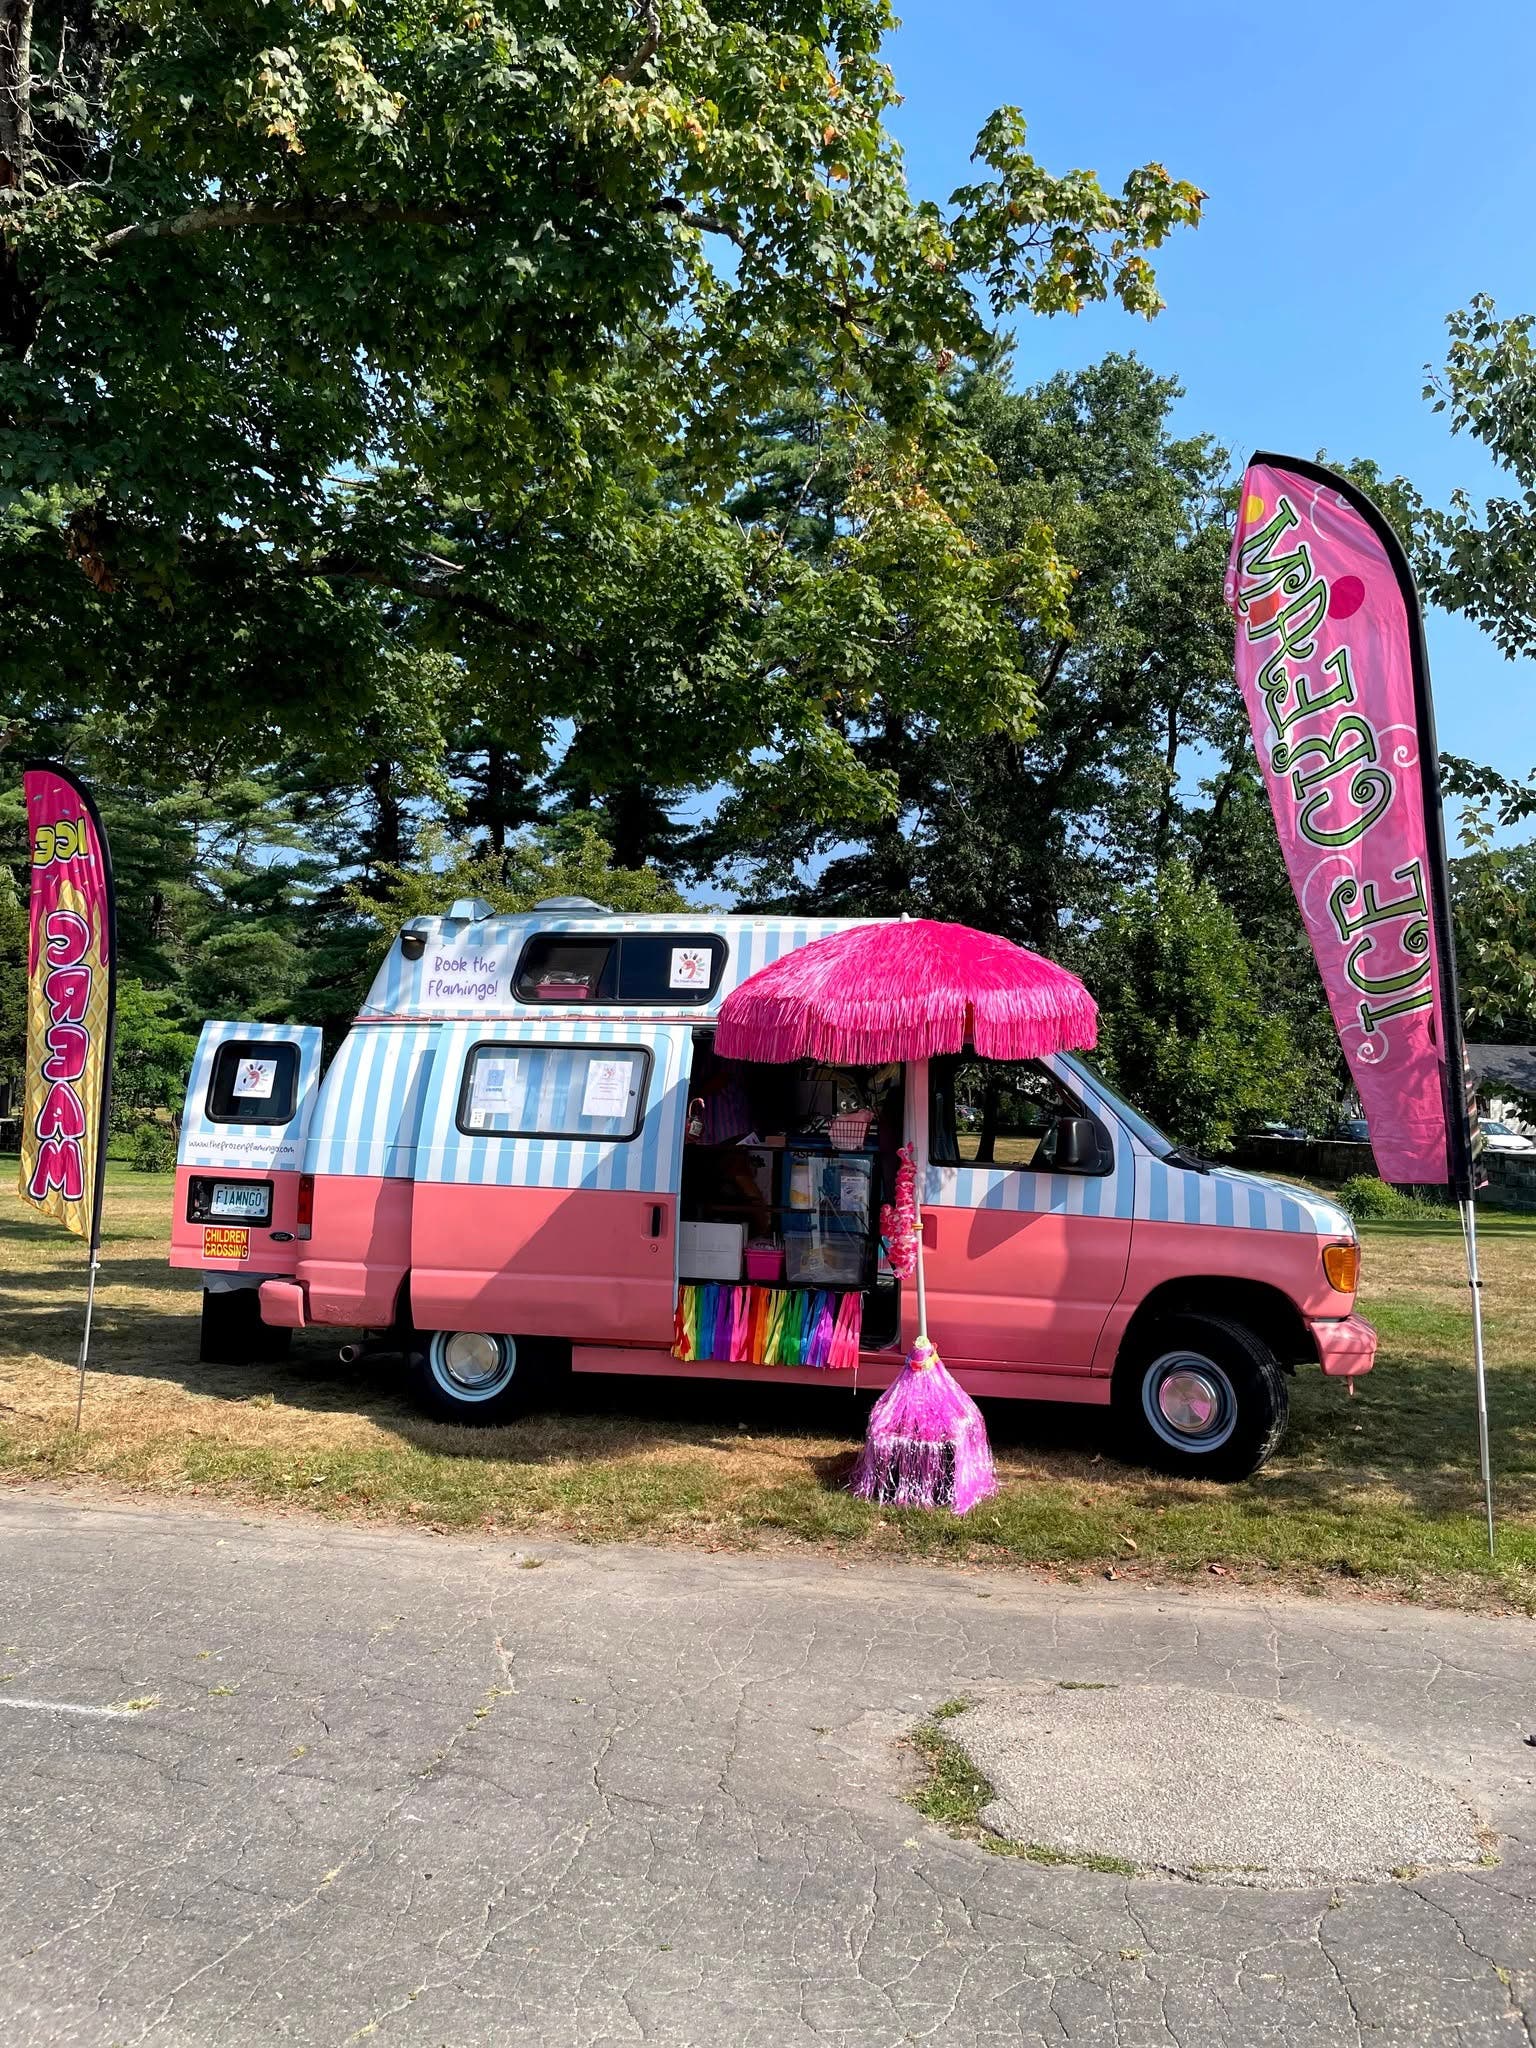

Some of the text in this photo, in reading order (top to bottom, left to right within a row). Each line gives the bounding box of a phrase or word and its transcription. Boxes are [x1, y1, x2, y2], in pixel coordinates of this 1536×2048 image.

[434, 956, 496, 972] Book the
[428, 979, 498, 1000] Flamingo!
[205, 1229, 247, 1243] CHILDREN
[205, 1244, 248, 1257] CROSSING
